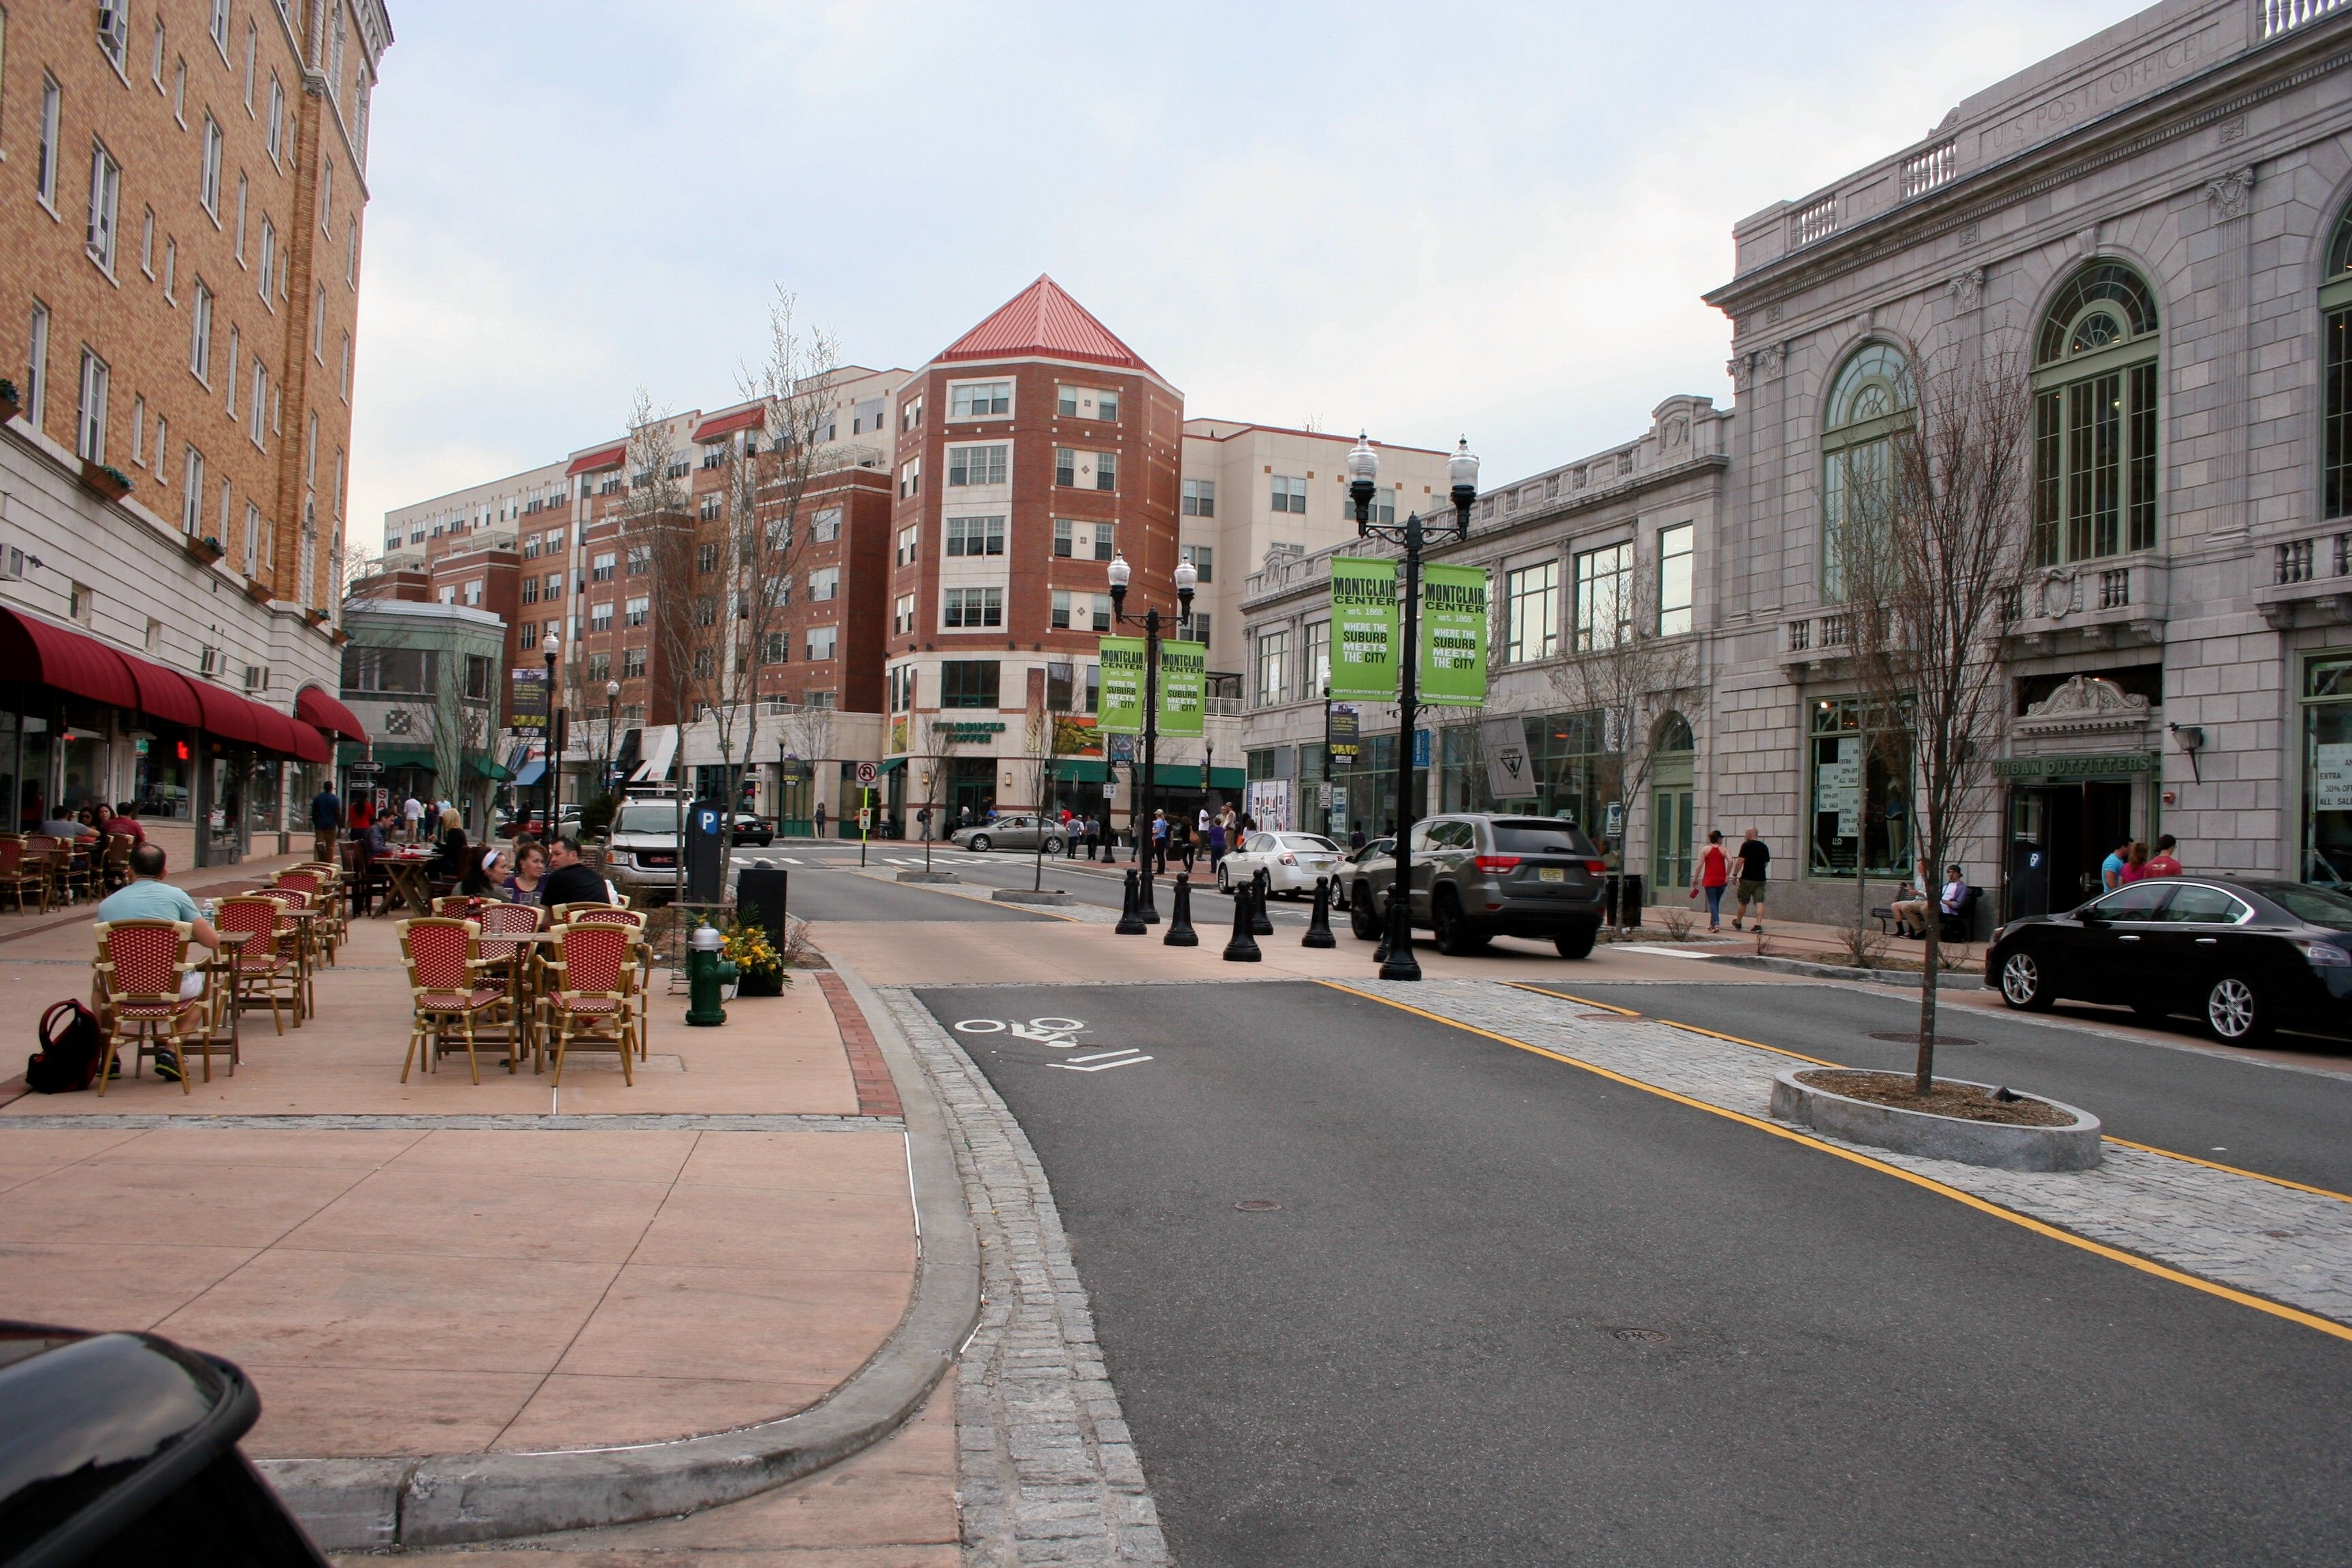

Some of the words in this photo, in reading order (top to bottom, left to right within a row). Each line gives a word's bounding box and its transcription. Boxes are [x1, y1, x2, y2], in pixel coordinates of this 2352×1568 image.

[2036, 89, 2096, 131] POST
[2110, 37, 2197, 94] OFFICE
[1334, 577, 1395, 597] MONTCLAIR
[1426, 583, 1484, 605] MONTCLAIR
[1334, 595, 1396, 606] CENTER
[1426, 602, 1484, 613] CENTER
[1343, 622, 1370, 632] WHERE
[1373, 623, 1387, 632] THE
[1343, 632, 1387, 642] SUBURB
[1434, 628, 1460, 638] WHERE
[1462, 630, 1475, 639] THE
[1343, 642, 1386, 652] MEETS
[1433, 637, 1475, 649] SUBURB
[1101, 650, 1143, 664] MONTCLAIR
[1343, 651, 1362, 662] THE
[1365, 653, 1386, 664] CITY
[1433, 648, 1475, 658] MEETS
[1101, 662, 1143, 670] CENTER
[1162, 654, 1203, 668] MONTCLAIR
[1433, 657, 1451, 668] THE
[1454, 658, 1475, 669] CITY
[1162, 666, 1204, 674] CENTER
[1107, 687, 1135, 696] SUBURB
[1167, 690, 1197, 699] SUBURB
[1107, 700, 1119, 708] THE
[1121, 700, 1135, 709] CITY
[1167, 704, 1180, 712] THE
[1181, 704, 1196, 713] CITY
[932, 722, 1005, 733] STARBUCKS
[1993, 762, 2040, 775] URBAN
[2046, 756, 2151, 774] OUTFITTERS
[702, 812, 715, 830] P
